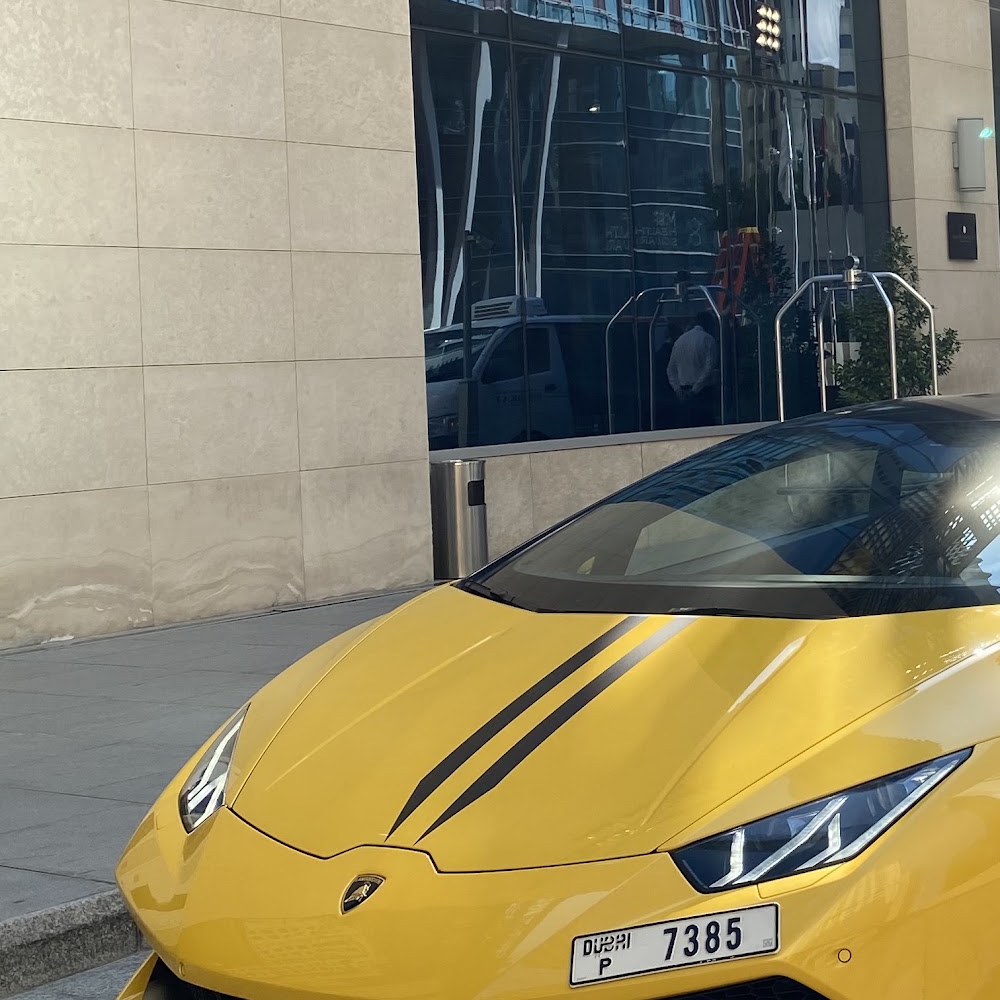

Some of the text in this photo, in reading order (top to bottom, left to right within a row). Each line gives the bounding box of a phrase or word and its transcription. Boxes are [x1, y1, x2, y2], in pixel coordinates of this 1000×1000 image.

[583, 917, 742, 961] DUBAI 7385
[600, 957, 612, 976] P
